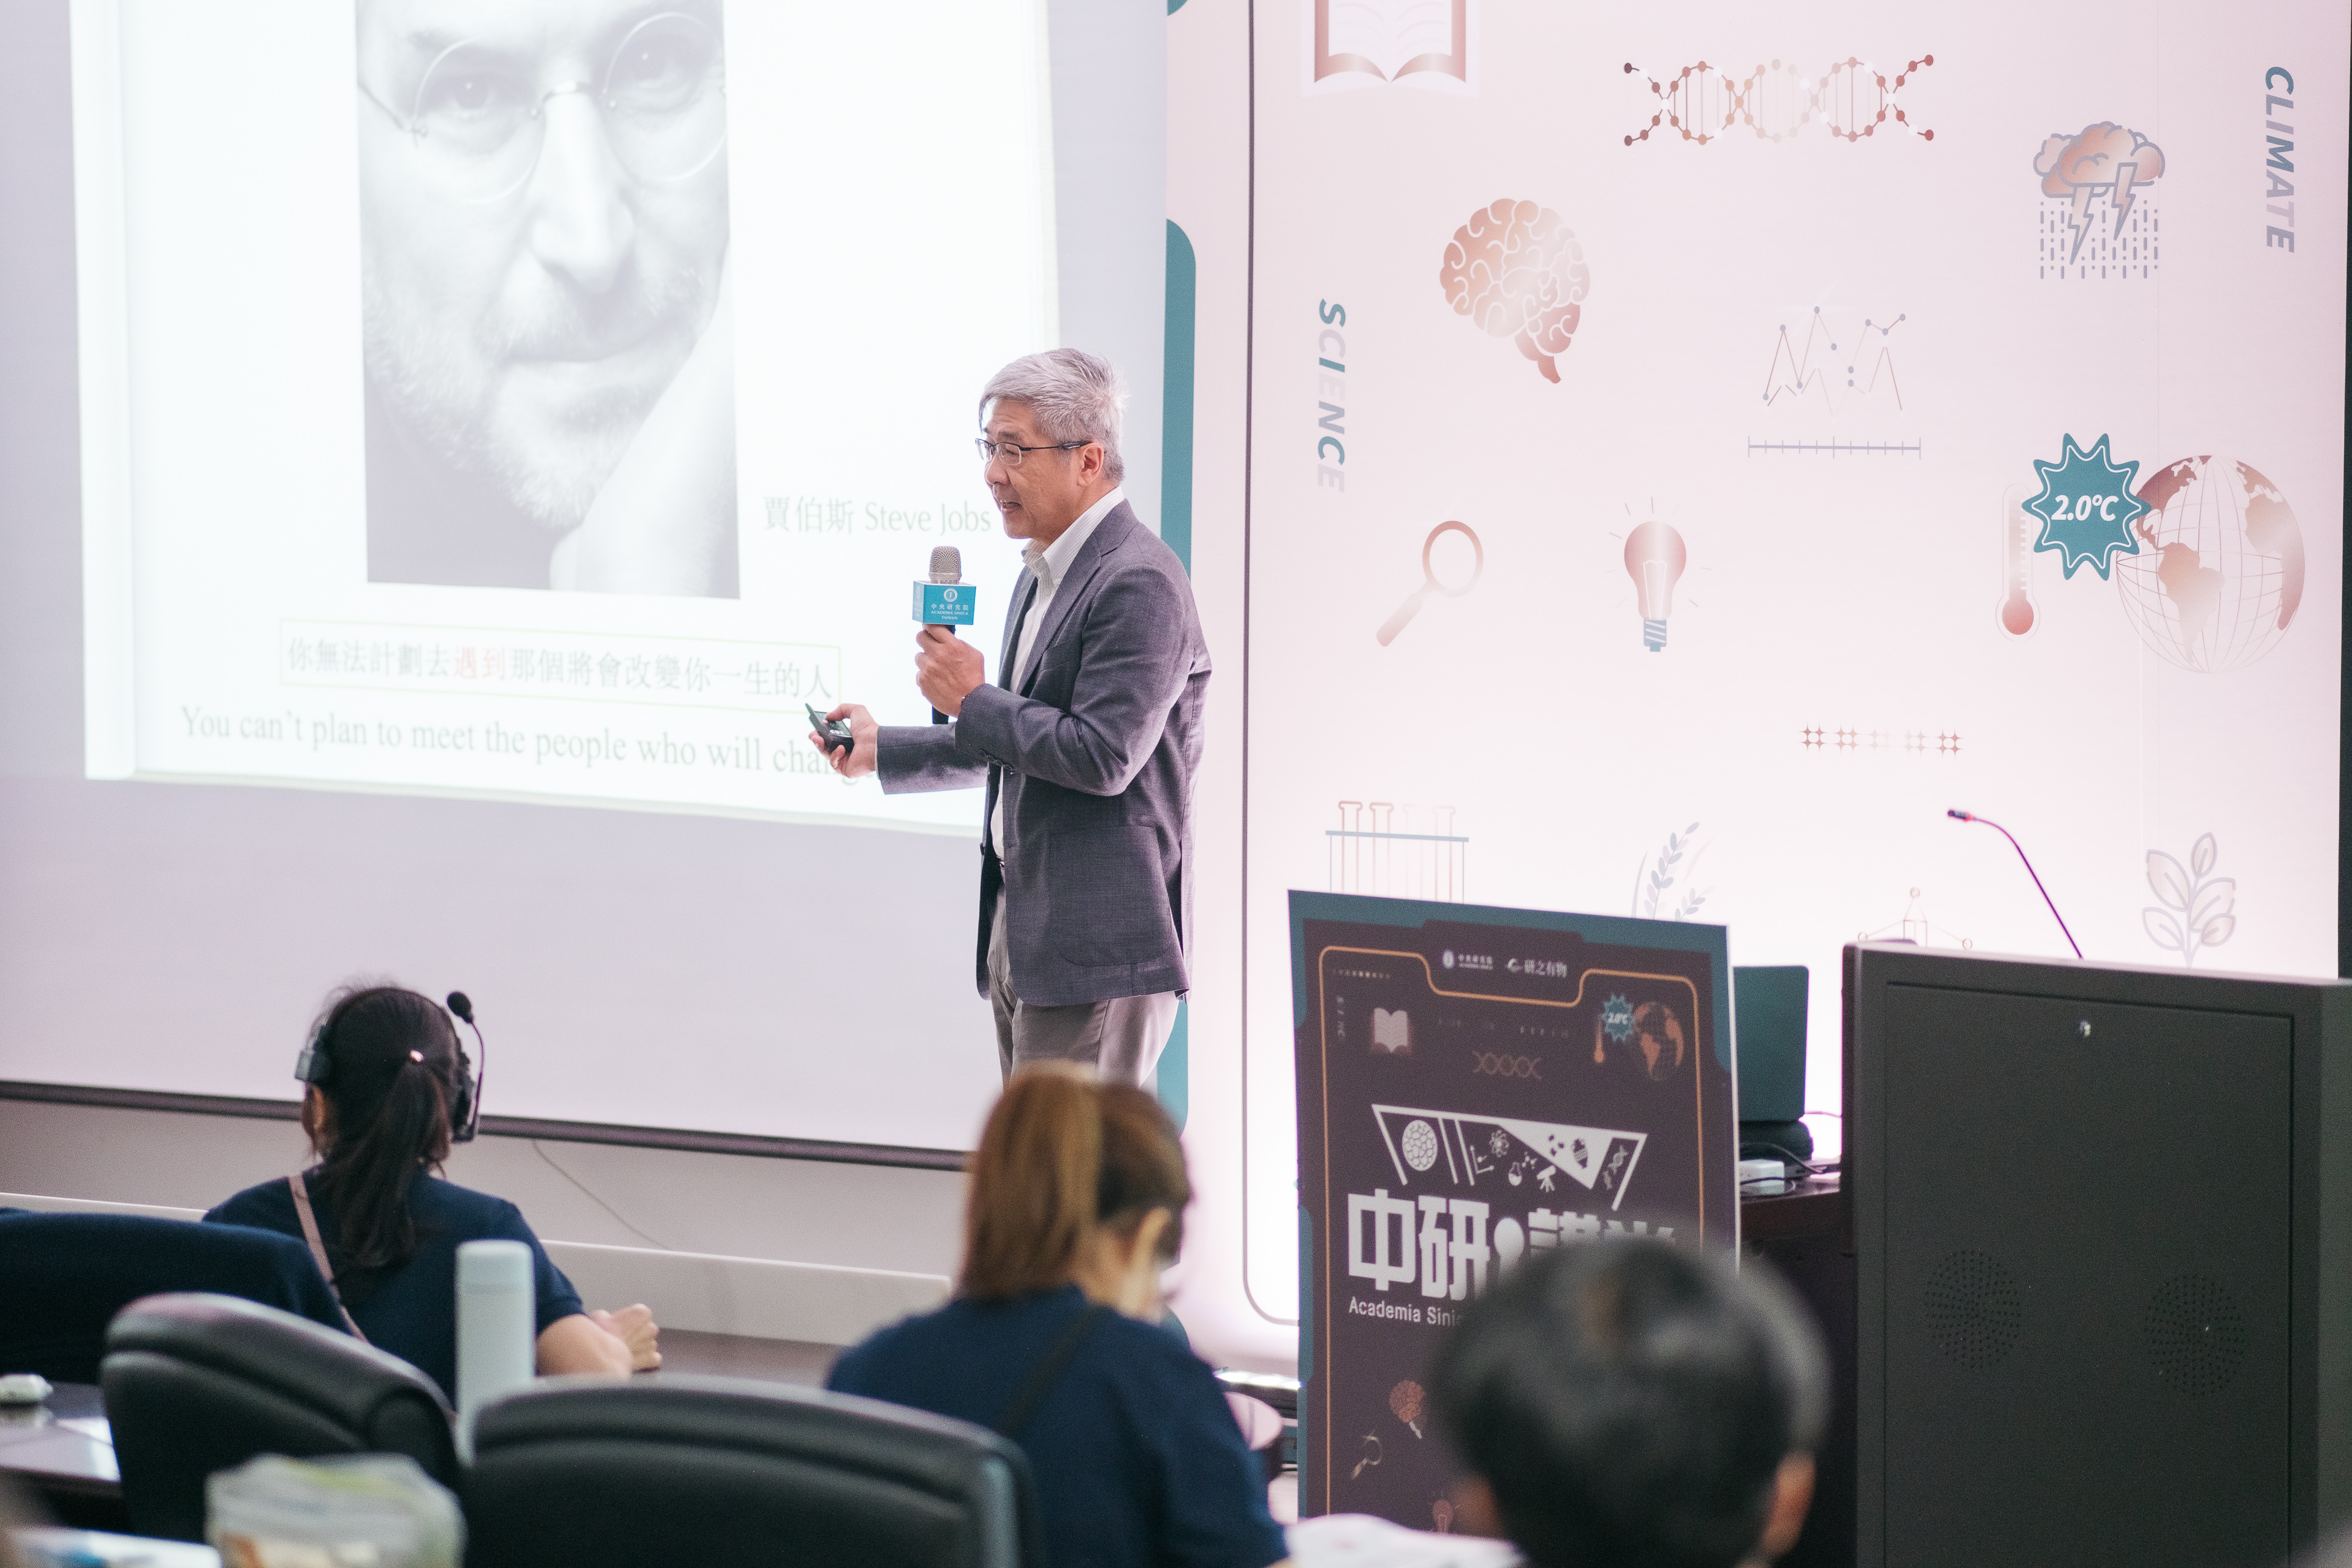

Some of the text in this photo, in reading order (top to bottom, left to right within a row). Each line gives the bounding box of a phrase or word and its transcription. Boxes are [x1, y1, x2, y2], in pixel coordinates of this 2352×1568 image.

[2265, 66, 2294, 253] CLIMATE
[1318, 298, 1346, 493] SCIENCE
[764, 496, 991, 536] 賈伯斯 Steve Jobs
[182, 706, 230, 738] You
[240, 710, 304, 741] can't
[312, 711, 368, 751] plan
[376, 720, 402, 747] to
[411, 724, 475, 751] meet
[485, 721, 526, 754] the
[535, 727, 627, 768] people
[637, 731, 696, 765] who
[707, 736, 762, 770] will
[1349, 1296, 1464, 1327] Academia Sini
